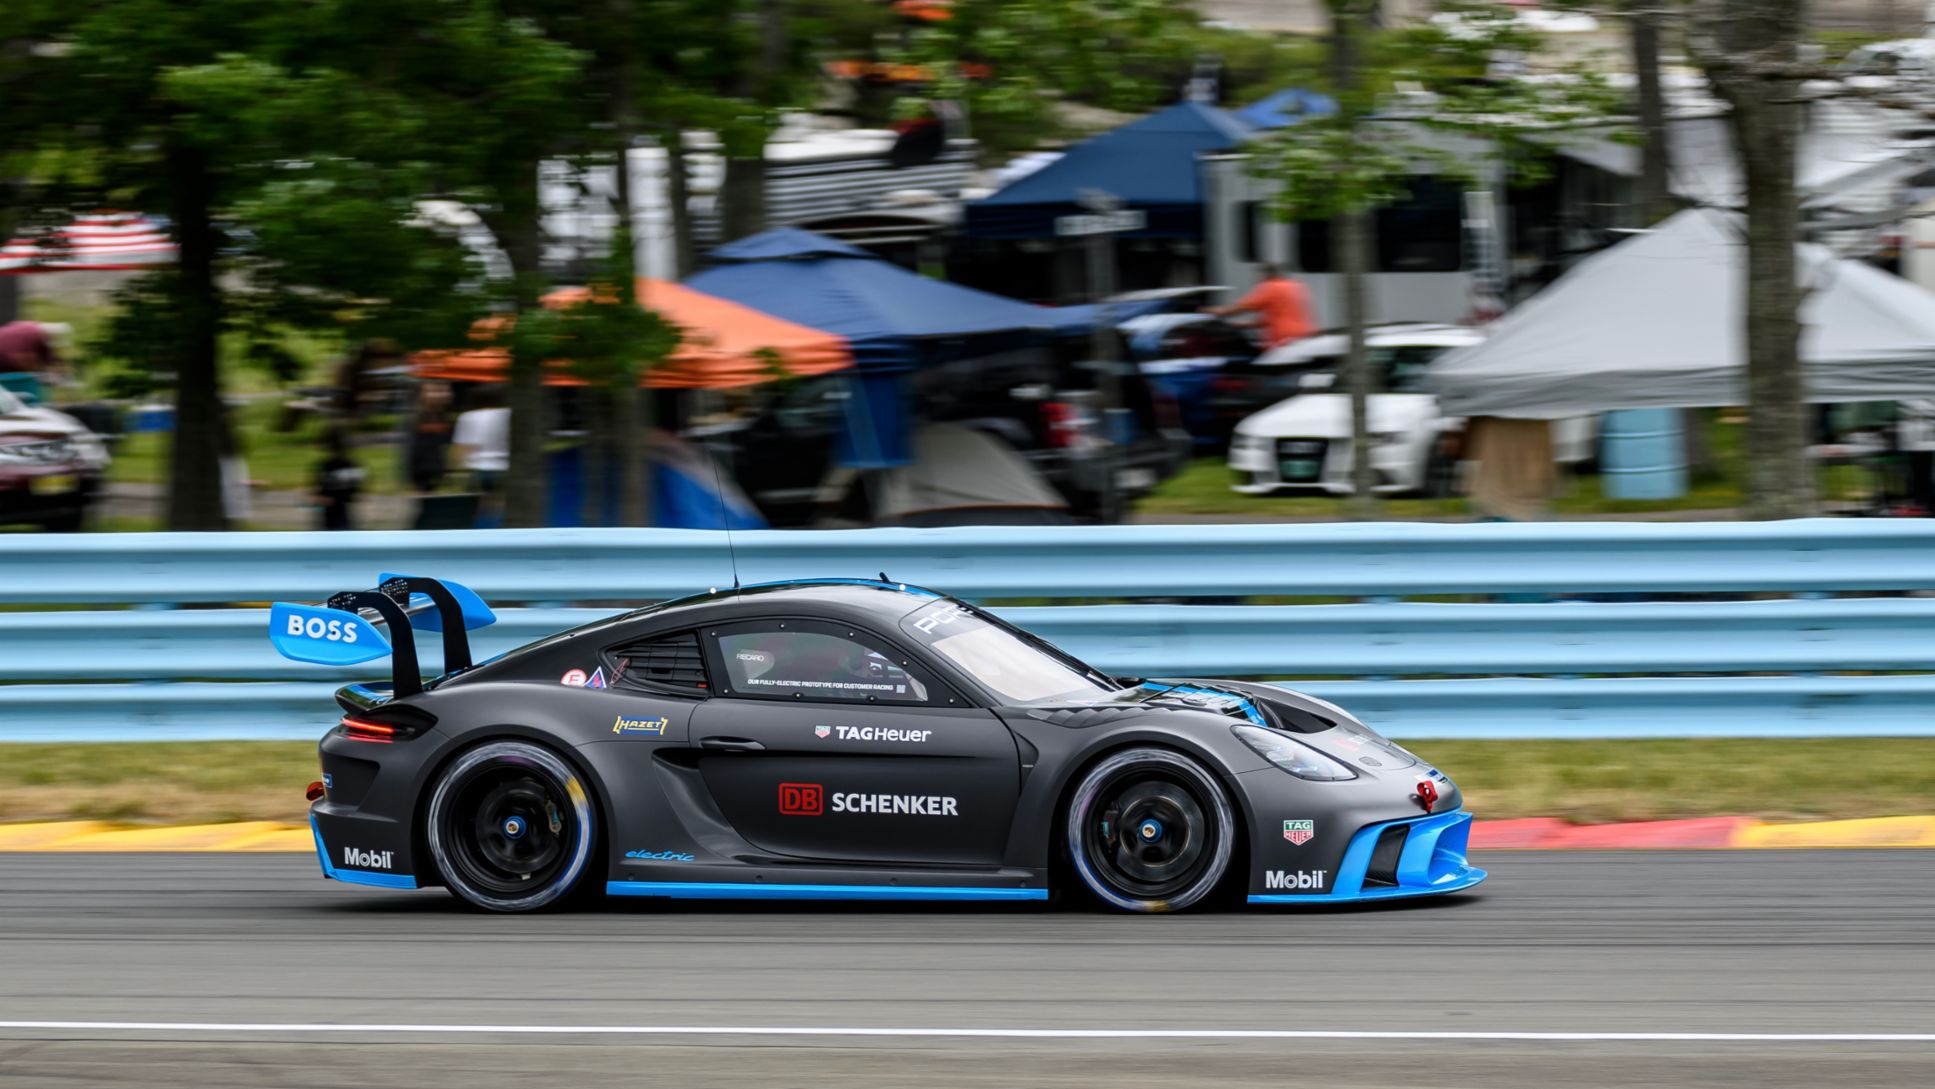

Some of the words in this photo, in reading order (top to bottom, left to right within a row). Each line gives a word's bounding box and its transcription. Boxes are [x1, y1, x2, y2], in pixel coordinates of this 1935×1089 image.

[287, 614, 358, 643] BOSS
[618, 719, 663, 731] HAZET
[784, 787, 818, 811] DB
[832, 792, 959, 816] SCHENKER
[1286, 821, 1312, 830] TAG
[1285, 831, 1312, 844] HEUER
[344, 846, 392, 869] Mobil
[625, 849, 696, 862] electric
[1265, 870, 1324, 889] Mobil
